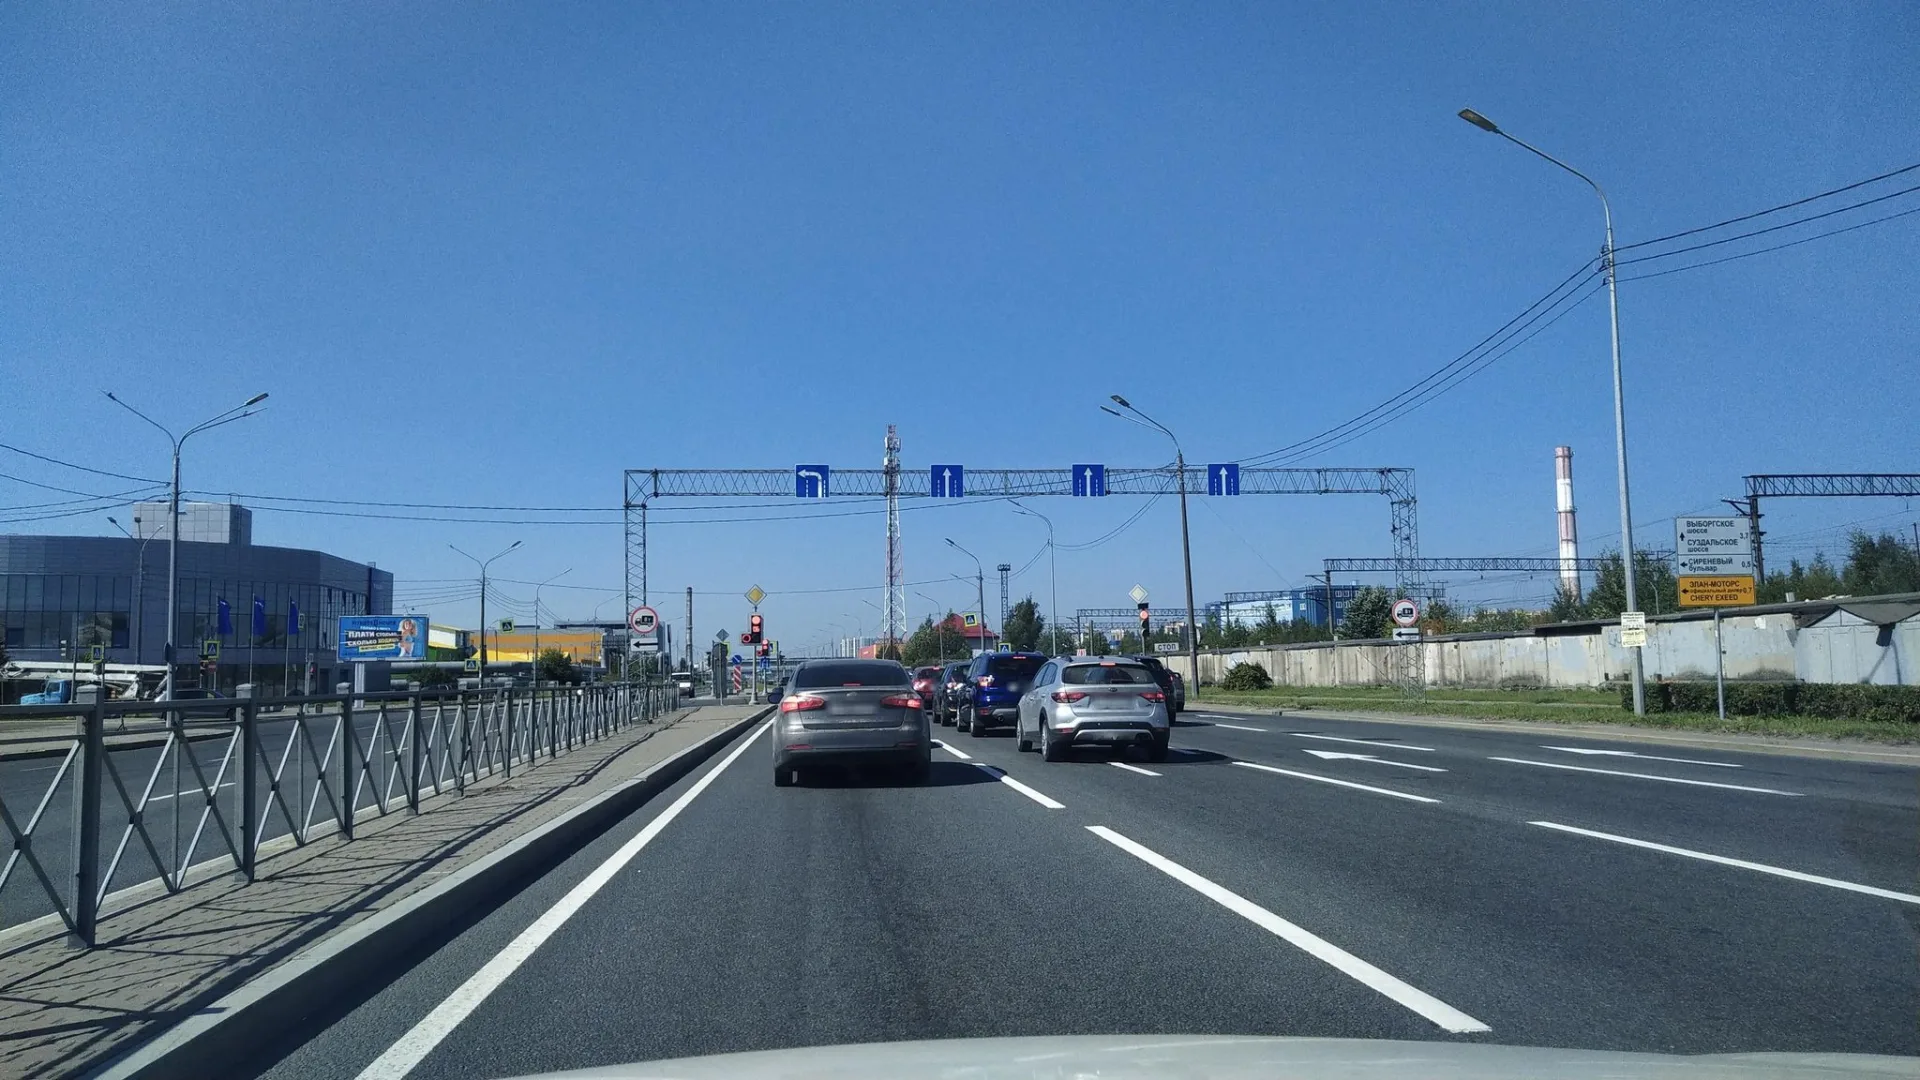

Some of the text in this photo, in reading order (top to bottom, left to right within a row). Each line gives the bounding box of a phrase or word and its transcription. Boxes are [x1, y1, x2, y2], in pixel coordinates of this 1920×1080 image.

[1686, 520, 1735, 528] ВЫБОРГСКОЕ
[1688, 557, 1733, 565] СИРЕНЕВЫЙ
[1741, 561, 1751, 569] 0,5
[1688, 565, 1718, 573] бульвар
[1690, 594, 1714, 602] CHERY
[1158, 643, 1177, 651] СТОП
